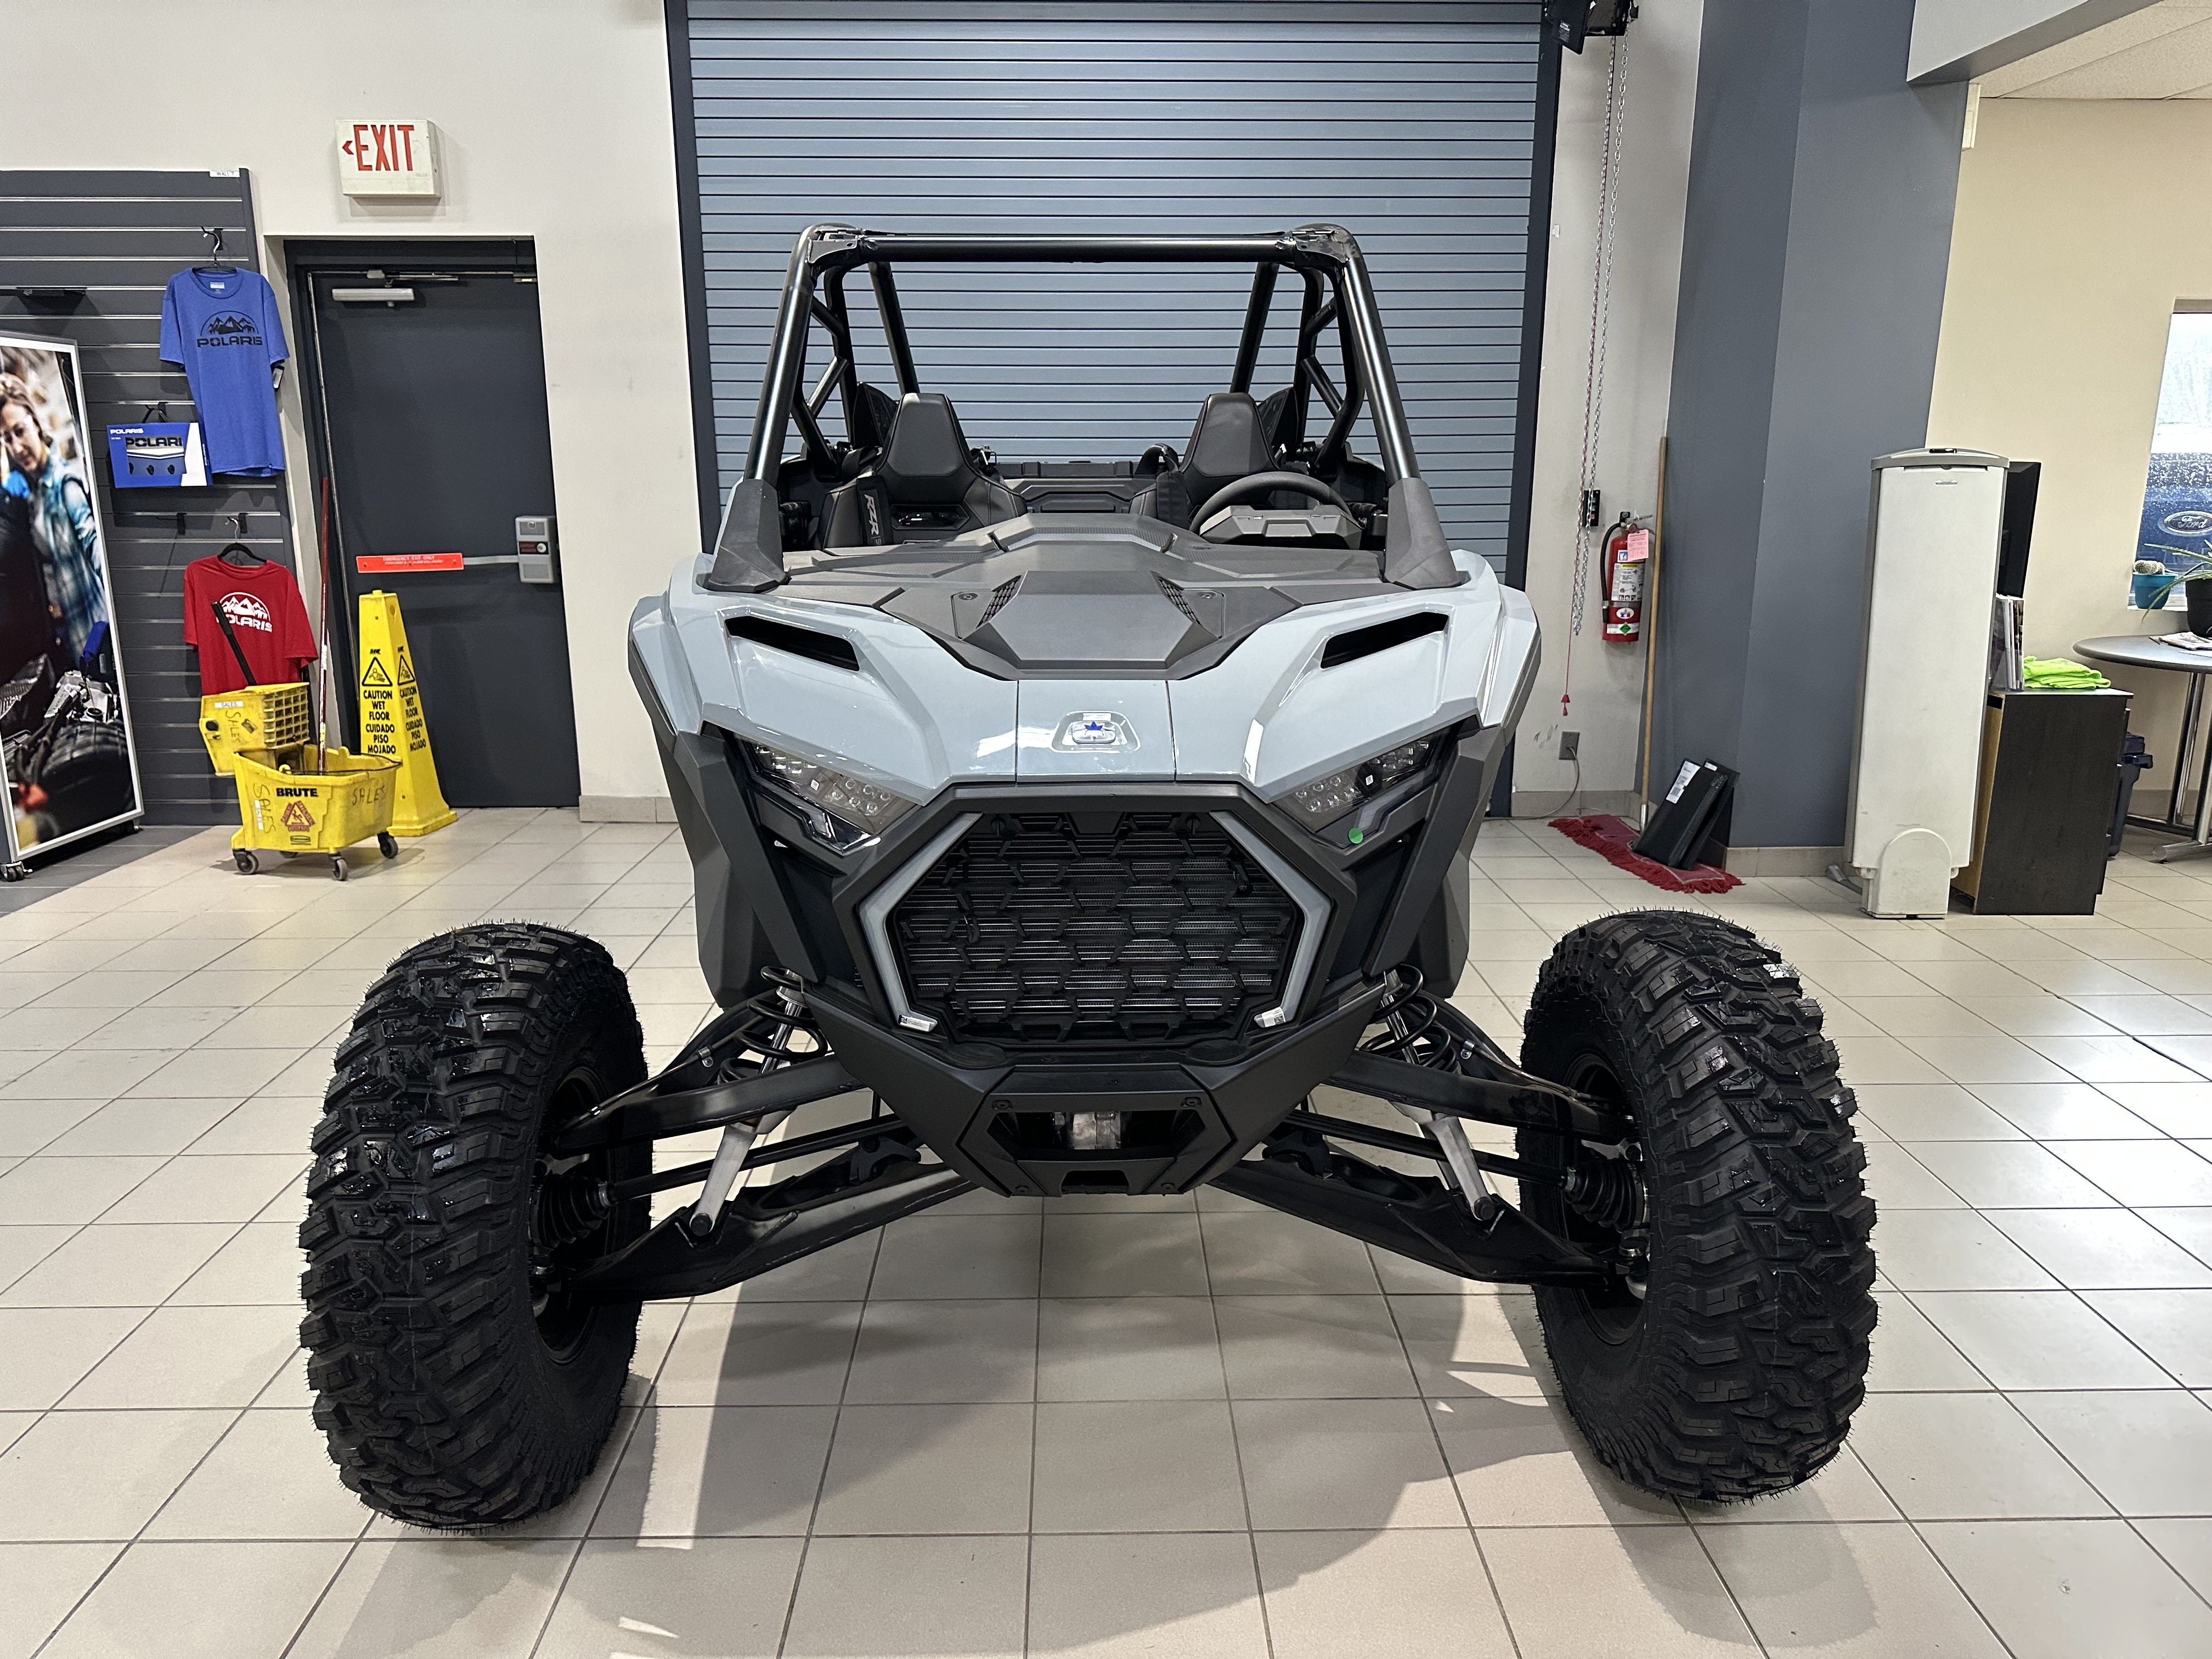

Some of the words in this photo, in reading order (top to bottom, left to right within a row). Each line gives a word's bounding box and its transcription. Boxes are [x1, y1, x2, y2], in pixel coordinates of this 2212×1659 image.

[353, 125, 415, 171] EXIT
[196, 336, 263, 347] POLARIS
[864, 494, 879, 535] RZR
[2177, 515, 2208, 528] Ford
[216, 614, 273, 633] OLARIS
[363, 690, 393, 699] CAUTION
[399, 686, 417, 698] CAUTION
[371, 701, 385, 710] WET
[405, 697, 414, 707] WET
[369, 712, 390, 720] FLOOR
[405, 707, 419, 719] FLOOR
[365, 724, 395, 733] CUIDADO
[405, 718, 423, 731] CUIDADO
[373, 734, 389, 743] PISO
[411, 730, 421, 740] PISO
[368, 744, 396, 754] MOJADO
[409, 738, 427, 752] MOJADO
[276, 787, 318, 797] BRUTE
